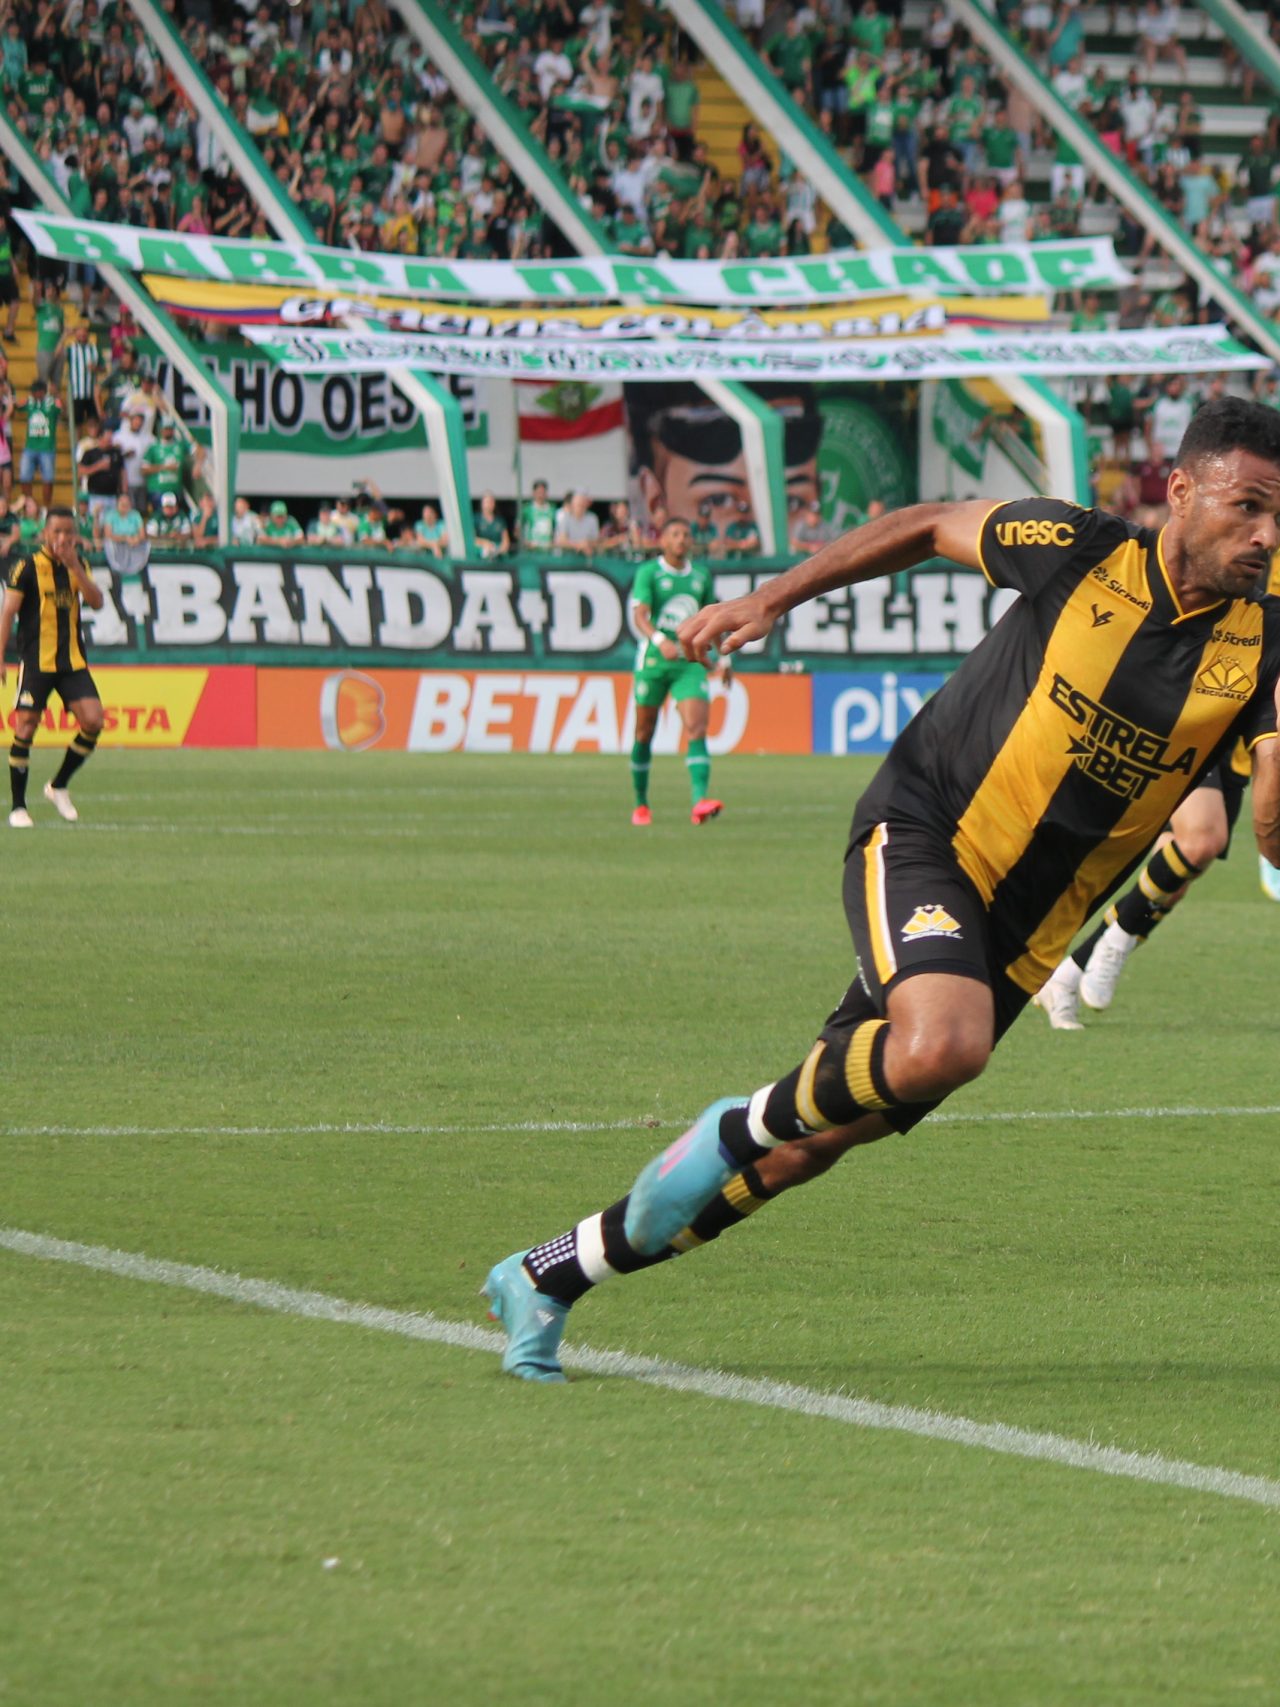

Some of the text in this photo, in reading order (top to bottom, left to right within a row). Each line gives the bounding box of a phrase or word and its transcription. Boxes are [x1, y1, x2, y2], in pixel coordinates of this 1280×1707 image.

[40, 221, 470, 291] BARRA
[322, 366, 476, 433] OESE
[996, 519, 1075, 547] unesc
[148, 561, 518, 651] BANDA
[1105, 578, 1150, 611] Sicredi
[1222, 631, 1262, 647] Sicredi
[1048, 672, 1198, 776] ESTRELA
[1086, 744, 1162, 800] BET
